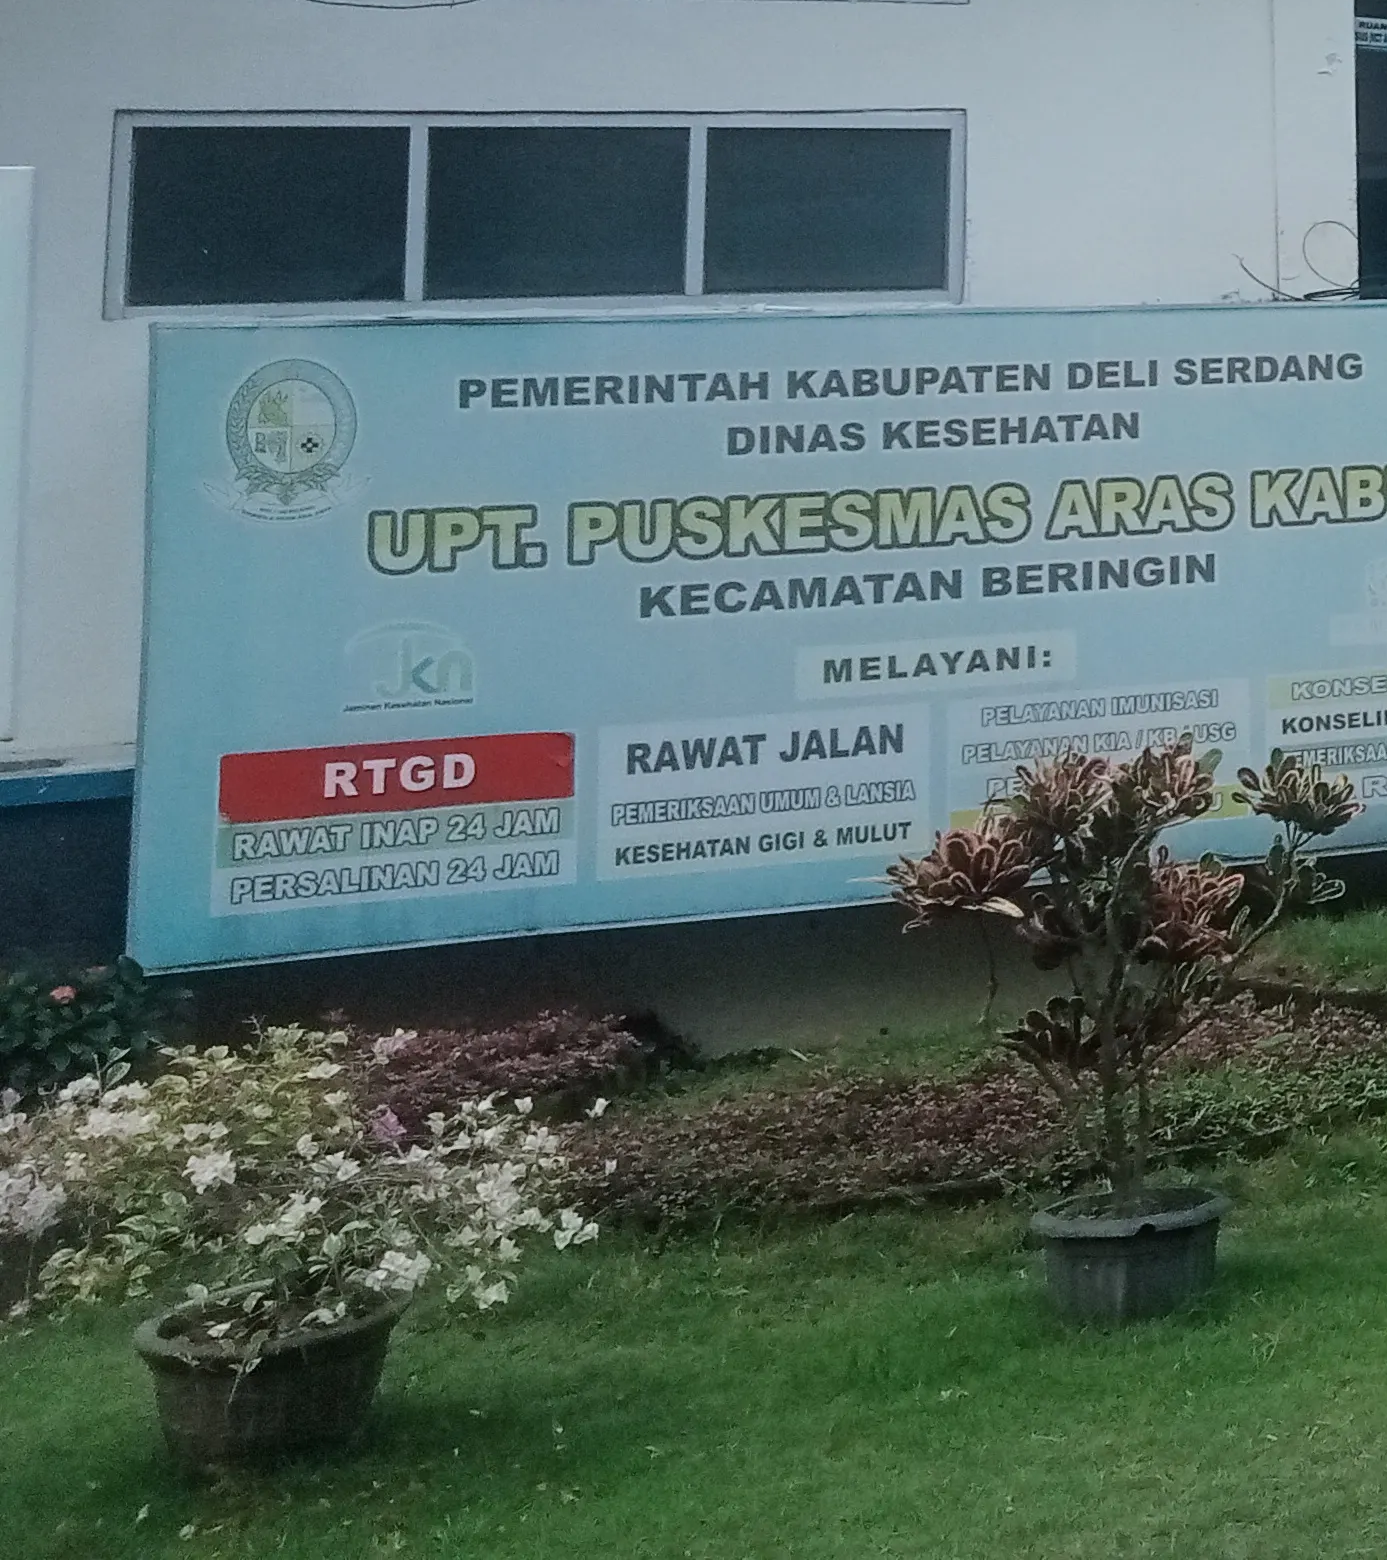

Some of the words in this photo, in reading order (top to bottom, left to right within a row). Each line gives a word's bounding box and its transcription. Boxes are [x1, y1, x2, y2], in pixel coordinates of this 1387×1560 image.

[458, 371, 770, 409] PEMERINTAH
[786, 363, 1051, 400] KABUPATEN
[1066, 359, 1158, 391] DELI
[1173, 352, 1363, 385] SERDANG
[727, 422, 866, 456] DINAS
[882, 412, 1140, 450] KESEHATAN
[368, 504, 548, 576] UPT.
[567, 481, 1032, 566] PUSKESMAS
[1045, 472, 1234, 540] ARAS
[639, 568, 962, 619] KECAMATAN
[982, 553, 1216, 598] BERINGIN
[822, 645, 1052, 684] MELAYANI:
[981, 696, 1106, 728] PELAYANAN
[1110, 689, 1219, 717] IMUNISASI
[626, 733, 767, 775] RAWAT
[779, 723, 904, 763] JALAN
[962, 733, 1089, 765] PELAYANAN
[1092, 730, 1131, 754] KIA
[1194, 722, 1237, 742] USG
[323, 752, 476, 799] RTGD
[611, 792, 756, 826] PEMERIKSAAN
[758, 786, 821, 813] UMUM
[825, 785, 841, 808] &
[844, 779, 916, 806] LANSIA
[232, 824, 353, 861] RAWAT
[360, 817, 439, 850] INAP
[446, 813, 486, 842] 24
[494, 807, 561, 837] JAM
[614, 836, 751, 867] KESEHATAN
[758, 831, 805, 853] GIGI
[813, 828, 828, 848] &
[835, 821, 912, 845] MULUT
[230, 860, 440, 905] PERSALINAN
[446, 856, 486, 884] 24
[492, 850, 559, 880] JAM
